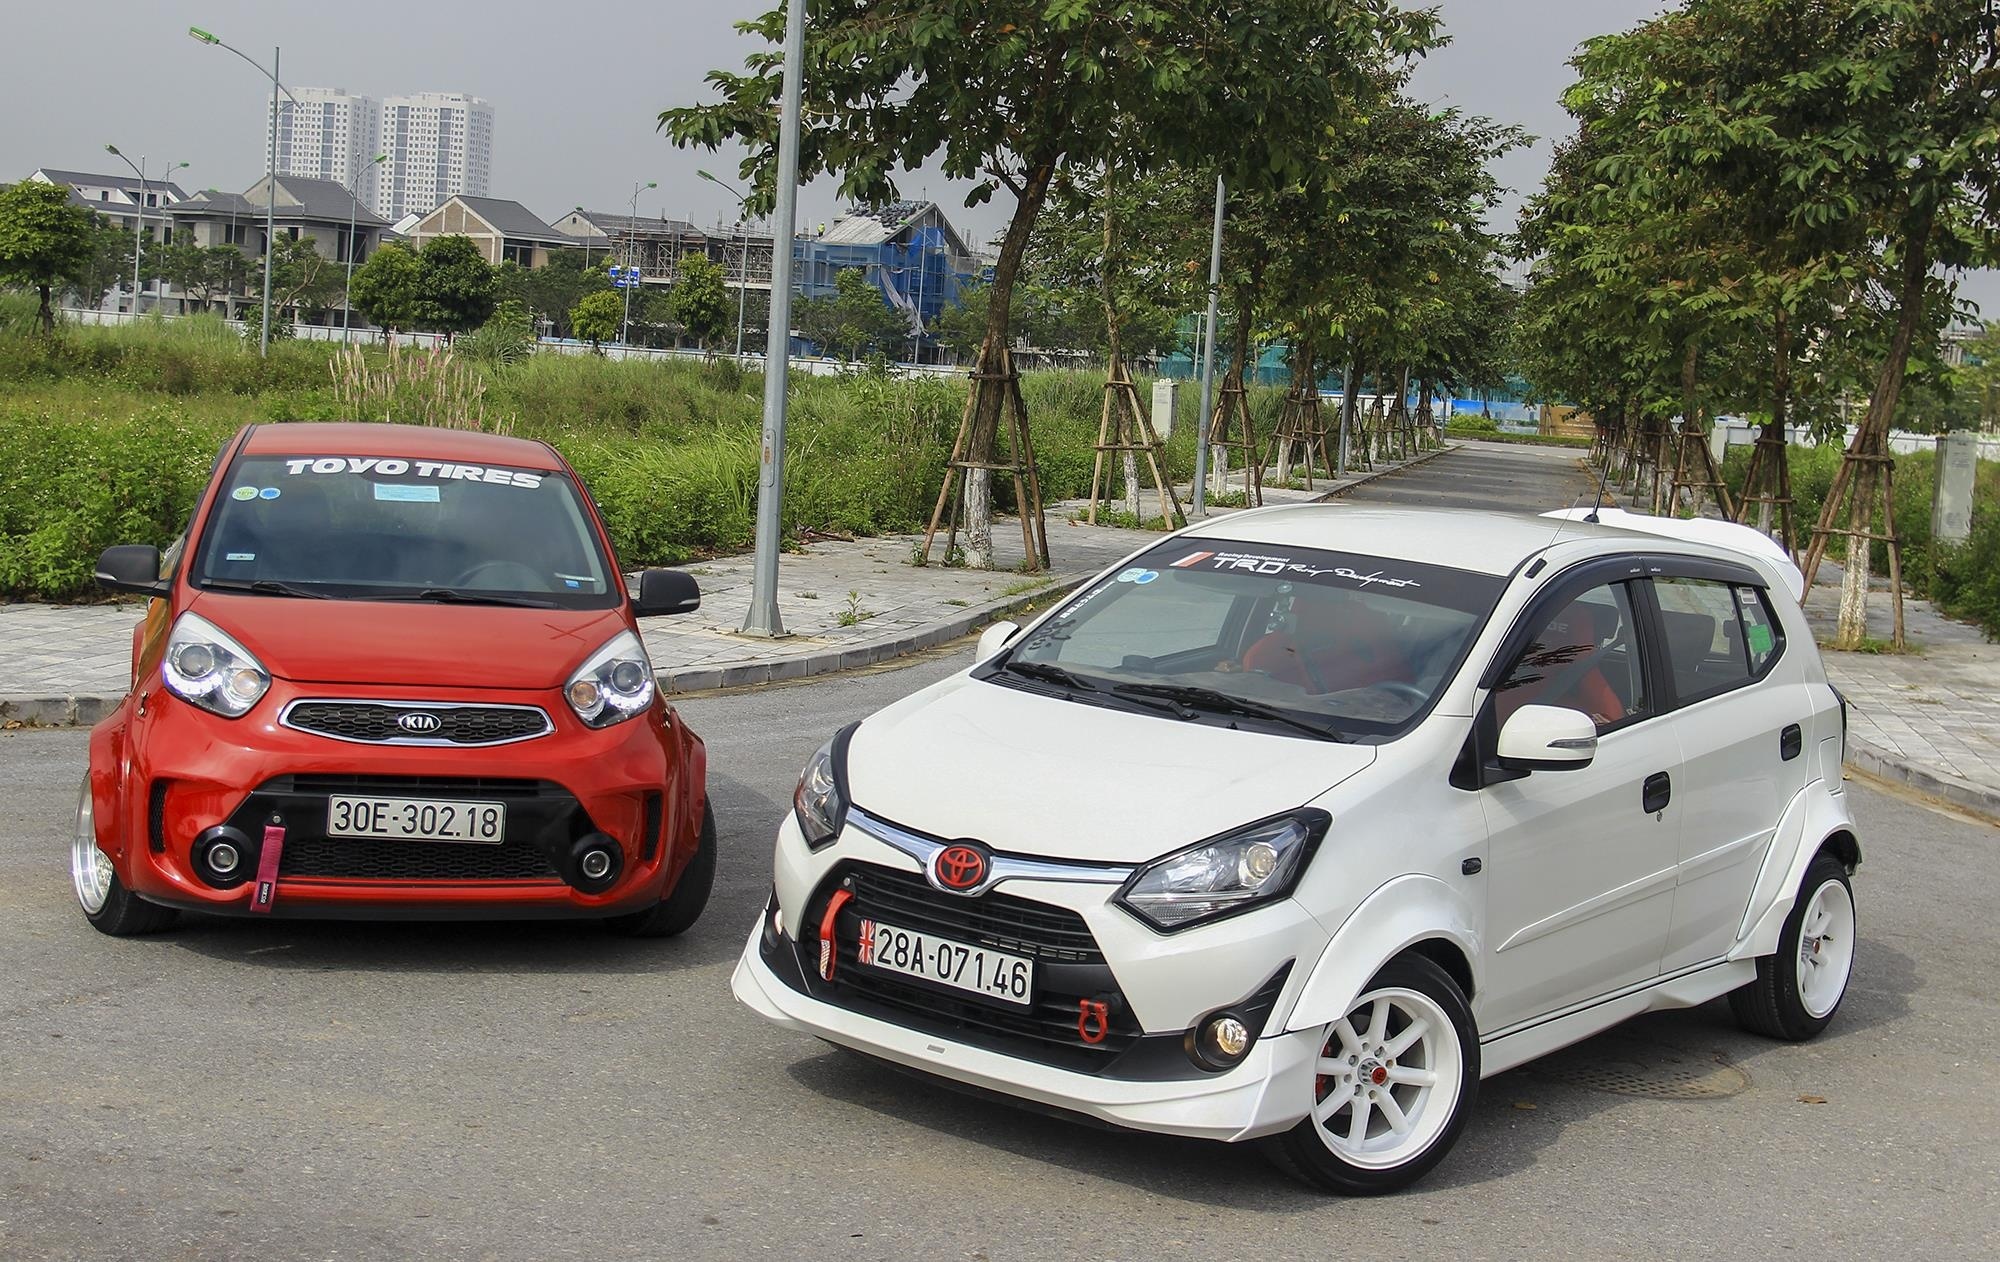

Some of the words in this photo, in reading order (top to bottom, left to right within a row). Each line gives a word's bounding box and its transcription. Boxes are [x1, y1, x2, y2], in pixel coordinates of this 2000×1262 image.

[286, 458, 409, 475] TOYO
[414, 461, 543, 489] TIRES
[1213, 556, 1286, 575] TRD
[406, 716, 435, 729] KIA
[334, 800, 498, 838] 30E-302.18
[877, 928, 1027, 998] 28A-071.46
